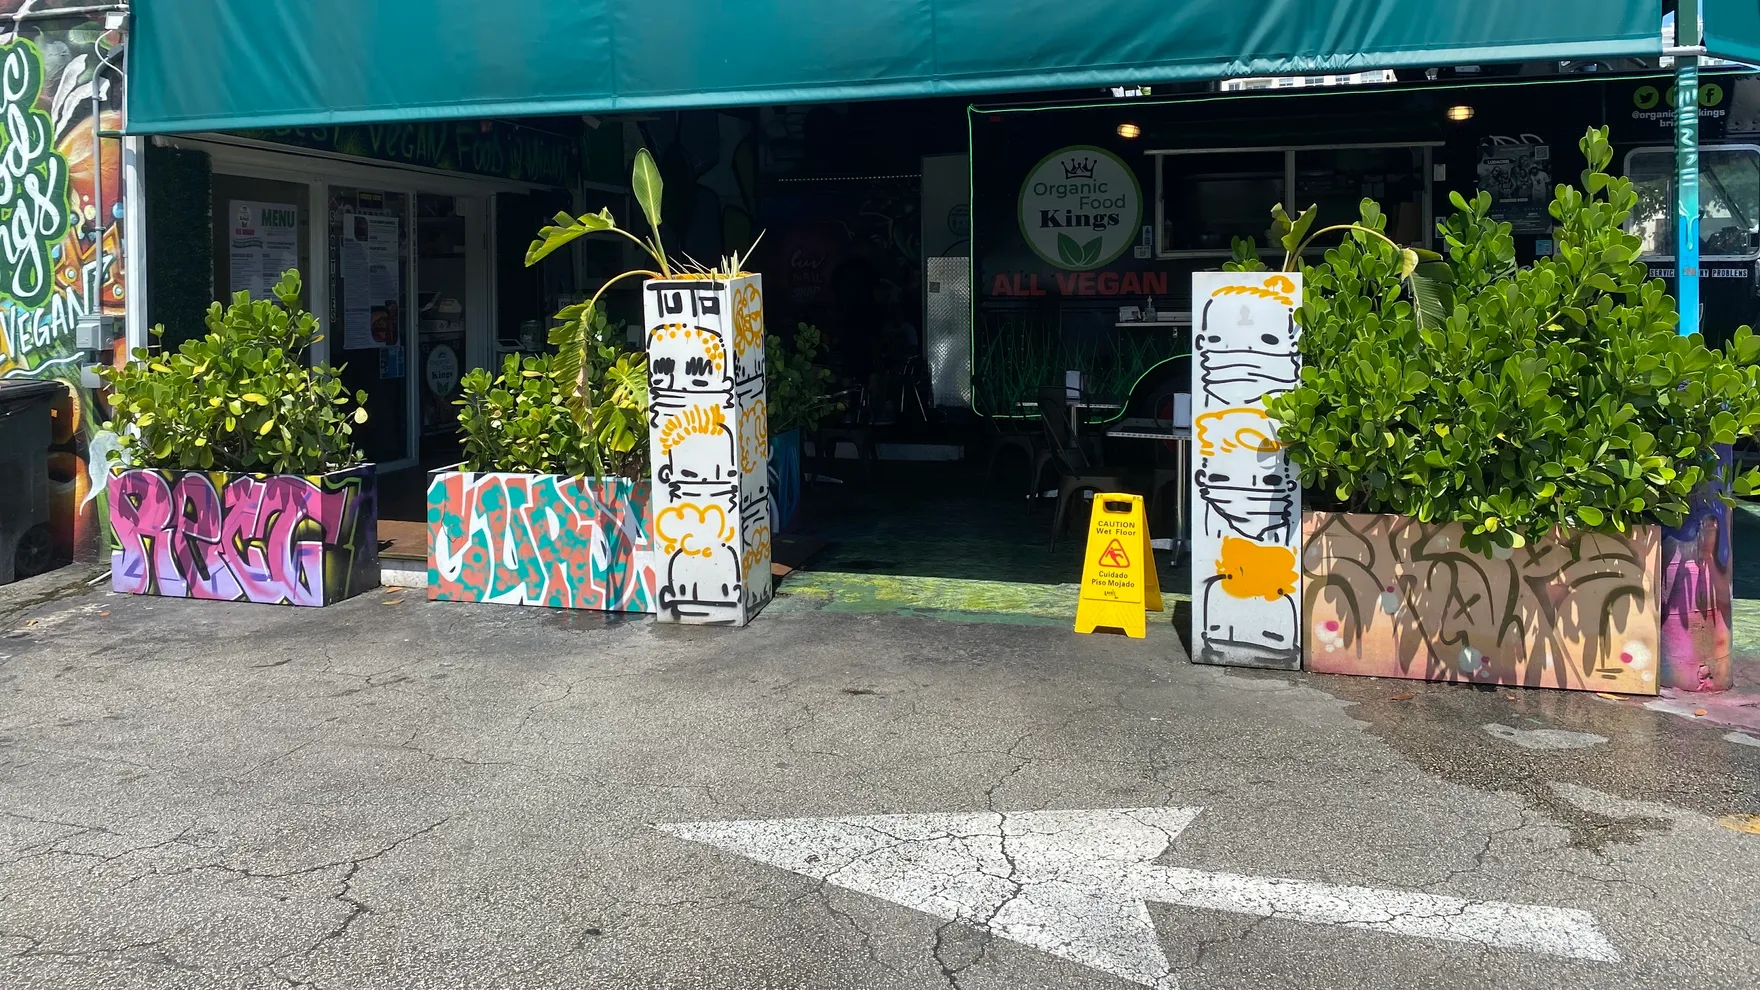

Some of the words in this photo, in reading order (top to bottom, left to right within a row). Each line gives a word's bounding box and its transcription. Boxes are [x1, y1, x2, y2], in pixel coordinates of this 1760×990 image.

[1033, 179, 1108, 198] Organic
[1079, 194, 1126, 210] Food
[261, 208, 295, 228] MENU
[1039, 209, 1120, 231] Kings
[1650, 268, 1675, 278] SERVIC
[1712, 268, 1748, 278] PROBLEMS
[991, 272, 1046, 296] ALL
[1055, 271, 1168, 296] VEGAN
[0, 263, 91, 358] VEGAN
[432, 371, 453, 380] Kings
[1098, 520, 1135, 528] CAUTION
[1096, 527, 1112, 535] Wet
[1115, 528, 1136, 536] Floor
[1098, 570, 1128, 579] Cuidado
[1091, 578, 1107, 586] Piso
[1107, 579, 1135, 588] Mojado
